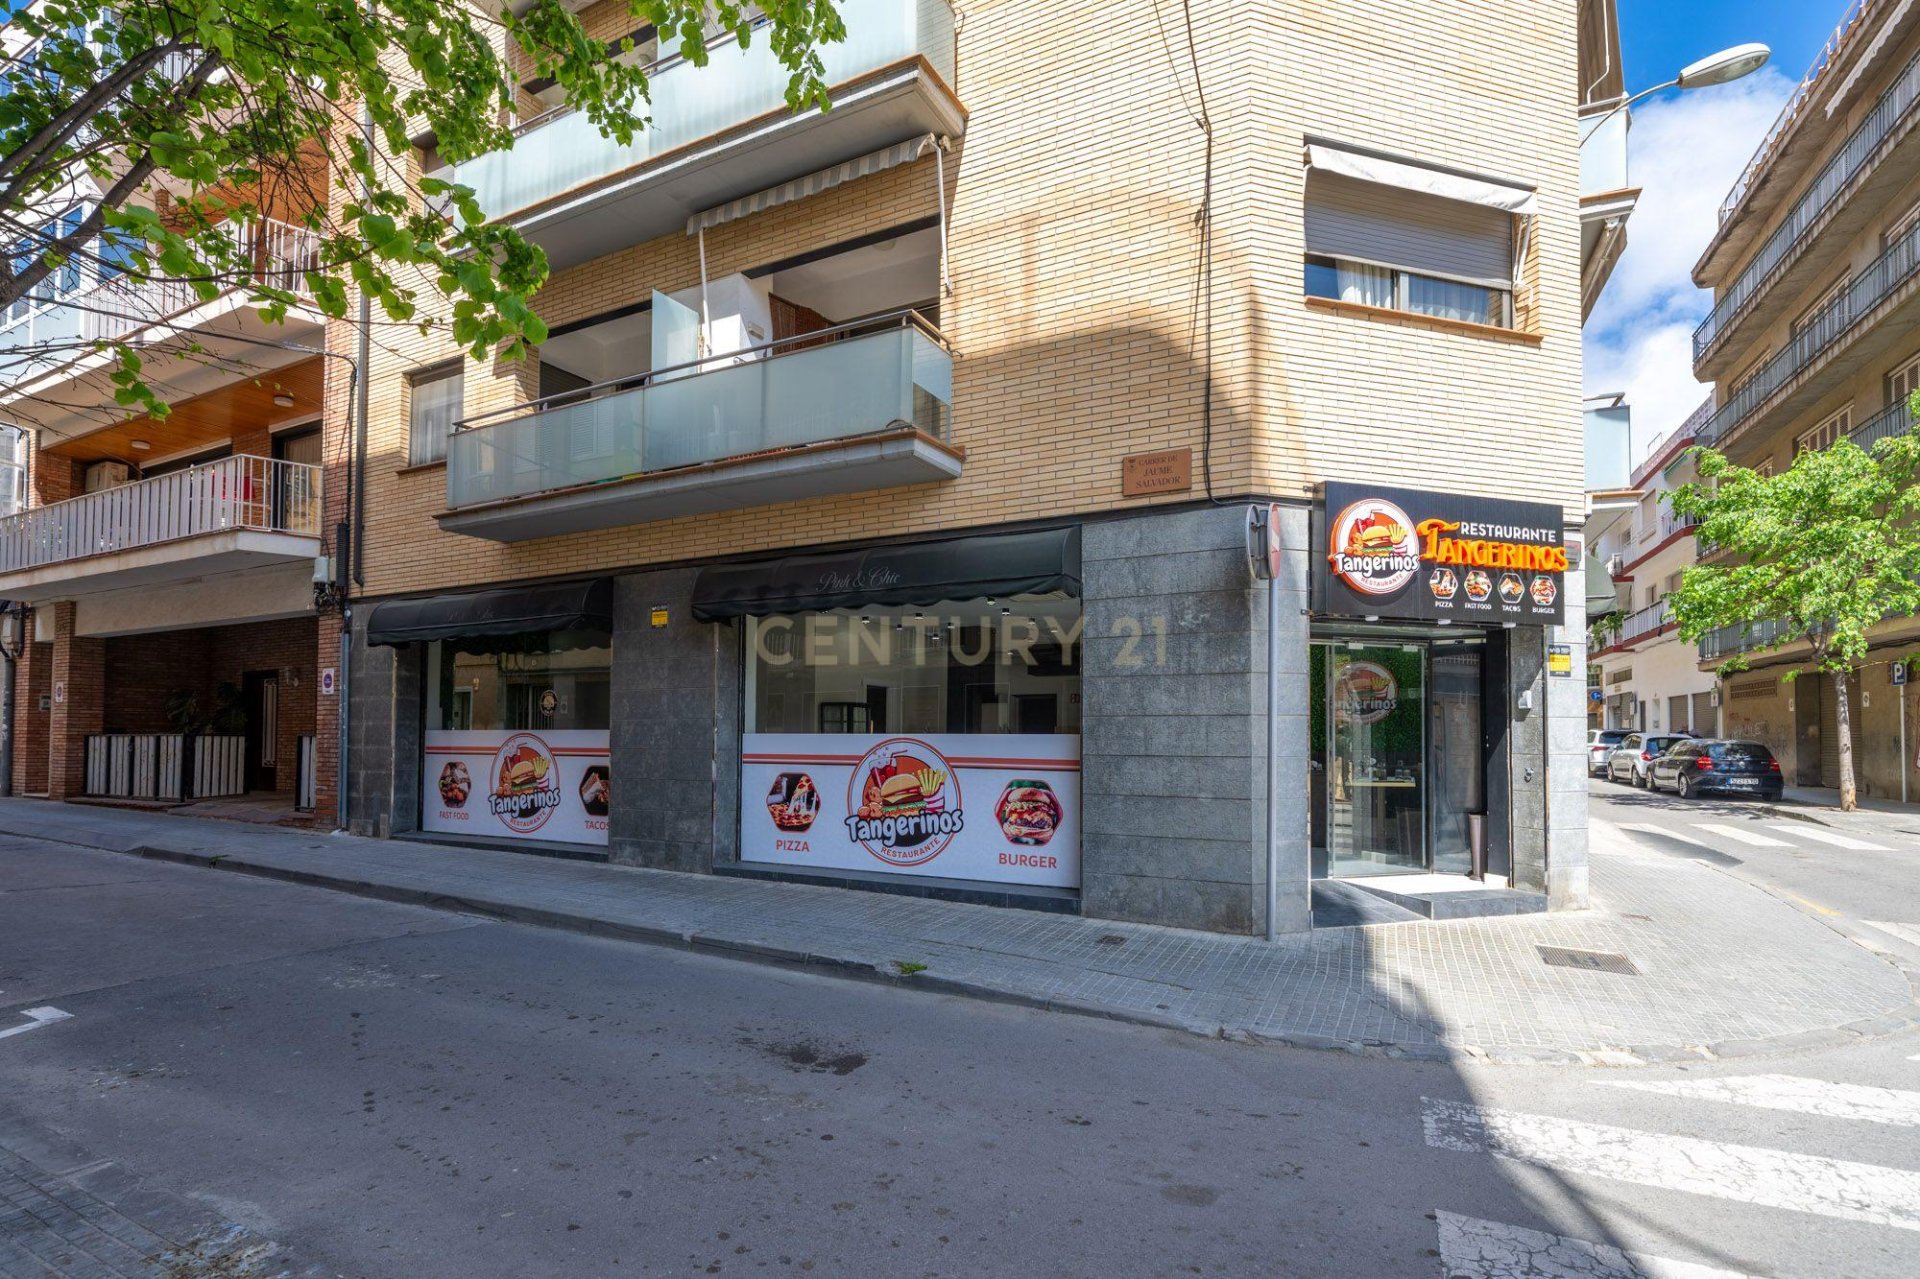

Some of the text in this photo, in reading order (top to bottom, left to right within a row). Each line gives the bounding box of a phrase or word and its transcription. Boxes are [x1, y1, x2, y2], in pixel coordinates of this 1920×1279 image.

[1139, 455, 1178, 466] CARRER DE
[1144, 466, 1173, 476] JAUME
[1136, 476, 1181, 488] SALVADOR
[1460, 522, 1556, 543] RESTAURANTE
[1334, 552, 1420, 580] Tangerinos
[869, 567, 901, 587] Chic
[1360, 573, 1404, 589] RESTAURANTE
[1435, 600, 1454, 609] PIZZA
[1464, 602, 1492, 611] FAST FOOD
[1502, 604, 1522, 613] TACOS
[1532, 606, 1555, 614] BURGER
[488, 788, 561, 818] Tangerinos
[439, 811, 469, 821] FAST FOOD
[509, 811, 547, 828] RESTAURANTE
[844, 808, 964, 847] Tangerinos
[776, 839, 810, 852] PIZZA
[880, 836, 941, 858] RESTAURANTE
[998, 852, 1057, 869] BURGER
